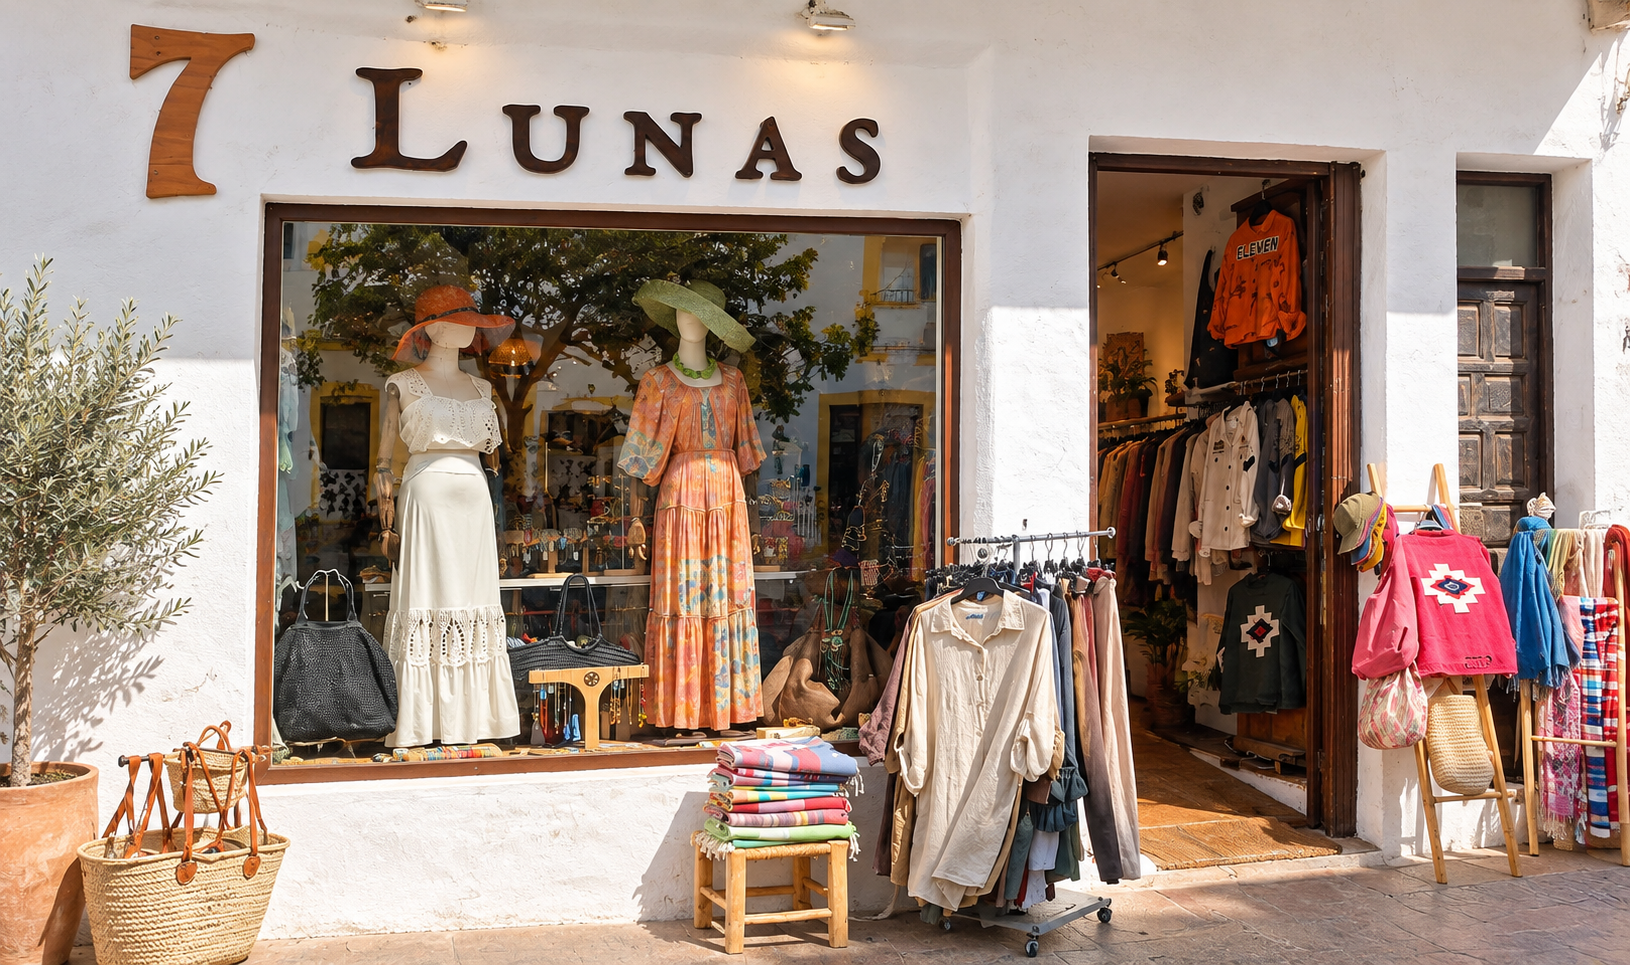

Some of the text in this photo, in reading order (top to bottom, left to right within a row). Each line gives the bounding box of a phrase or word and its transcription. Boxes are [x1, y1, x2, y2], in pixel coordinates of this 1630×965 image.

[129, 24, 881, 199] 7 LUNAS
[1236, 236, 1279, 261] ELEVEN
